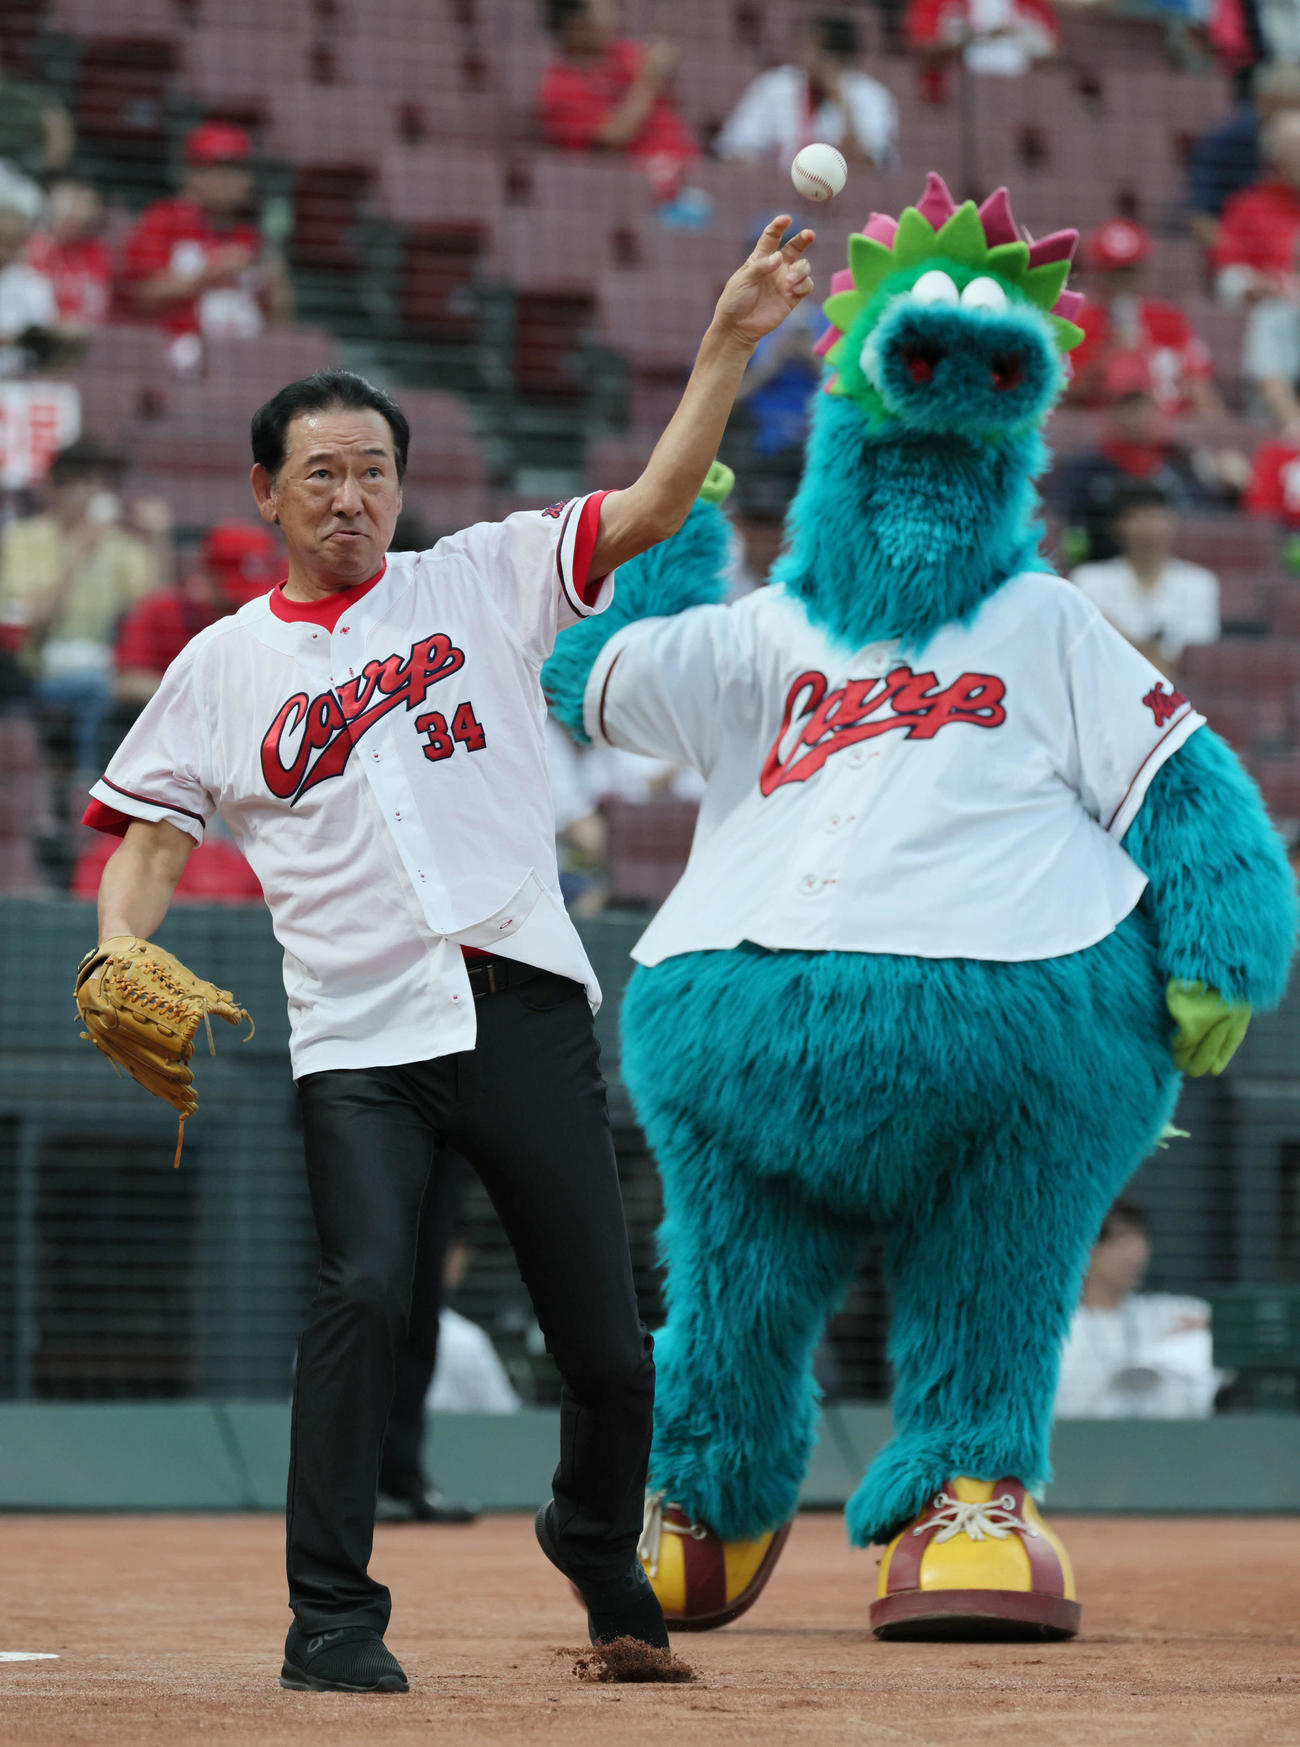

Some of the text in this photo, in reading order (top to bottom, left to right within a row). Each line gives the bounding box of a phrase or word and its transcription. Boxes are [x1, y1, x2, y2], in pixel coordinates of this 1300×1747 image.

[260, 633, 465, 808] Carp
[414, 701, 487, 762] 34
[760, 666, 1006, 797] Carp
